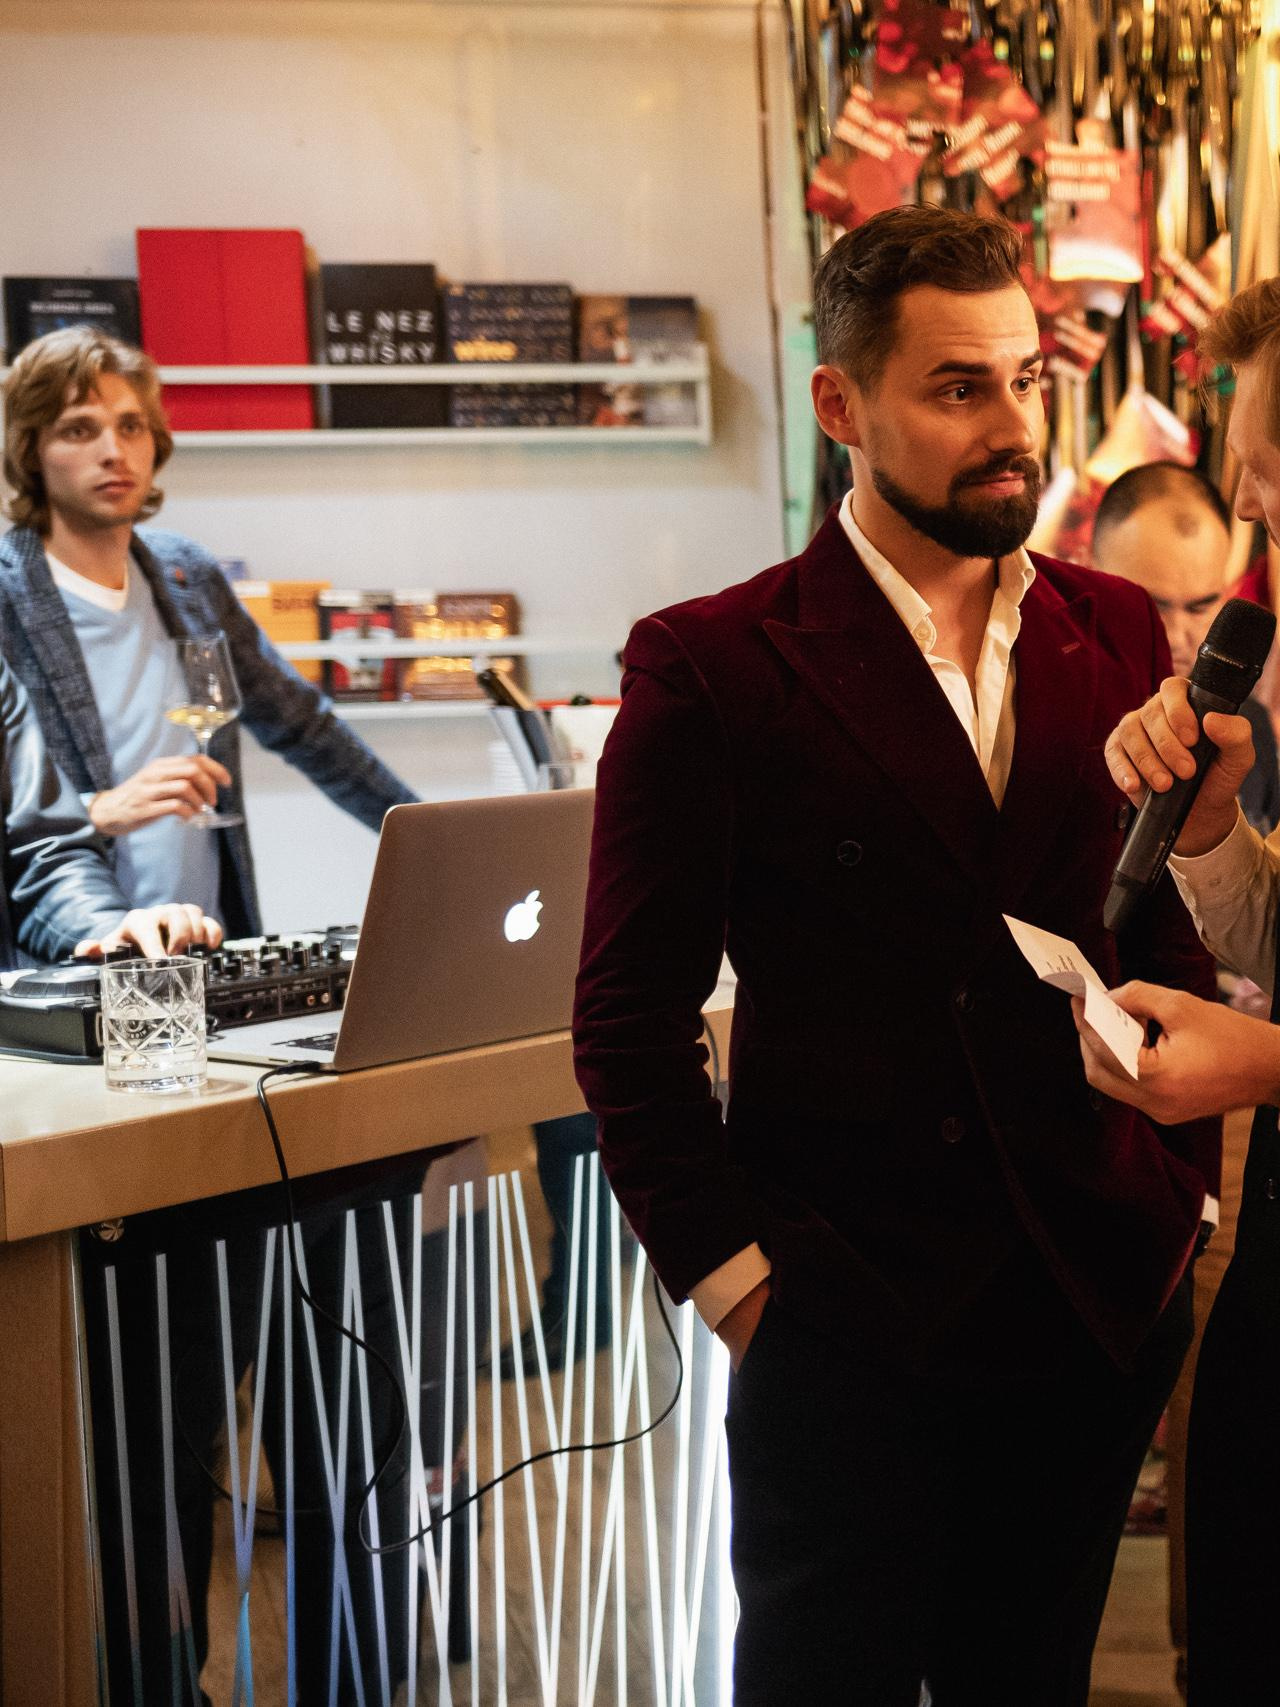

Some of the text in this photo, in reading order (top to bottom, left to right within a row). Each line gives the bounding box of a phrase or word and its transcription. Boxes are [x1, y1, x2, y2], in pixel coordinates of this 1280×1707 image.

[326, 310, 363, 333] LE
[376, 310, 434, 333] NEZ
[329, 341, 436, 364] WHISKY
